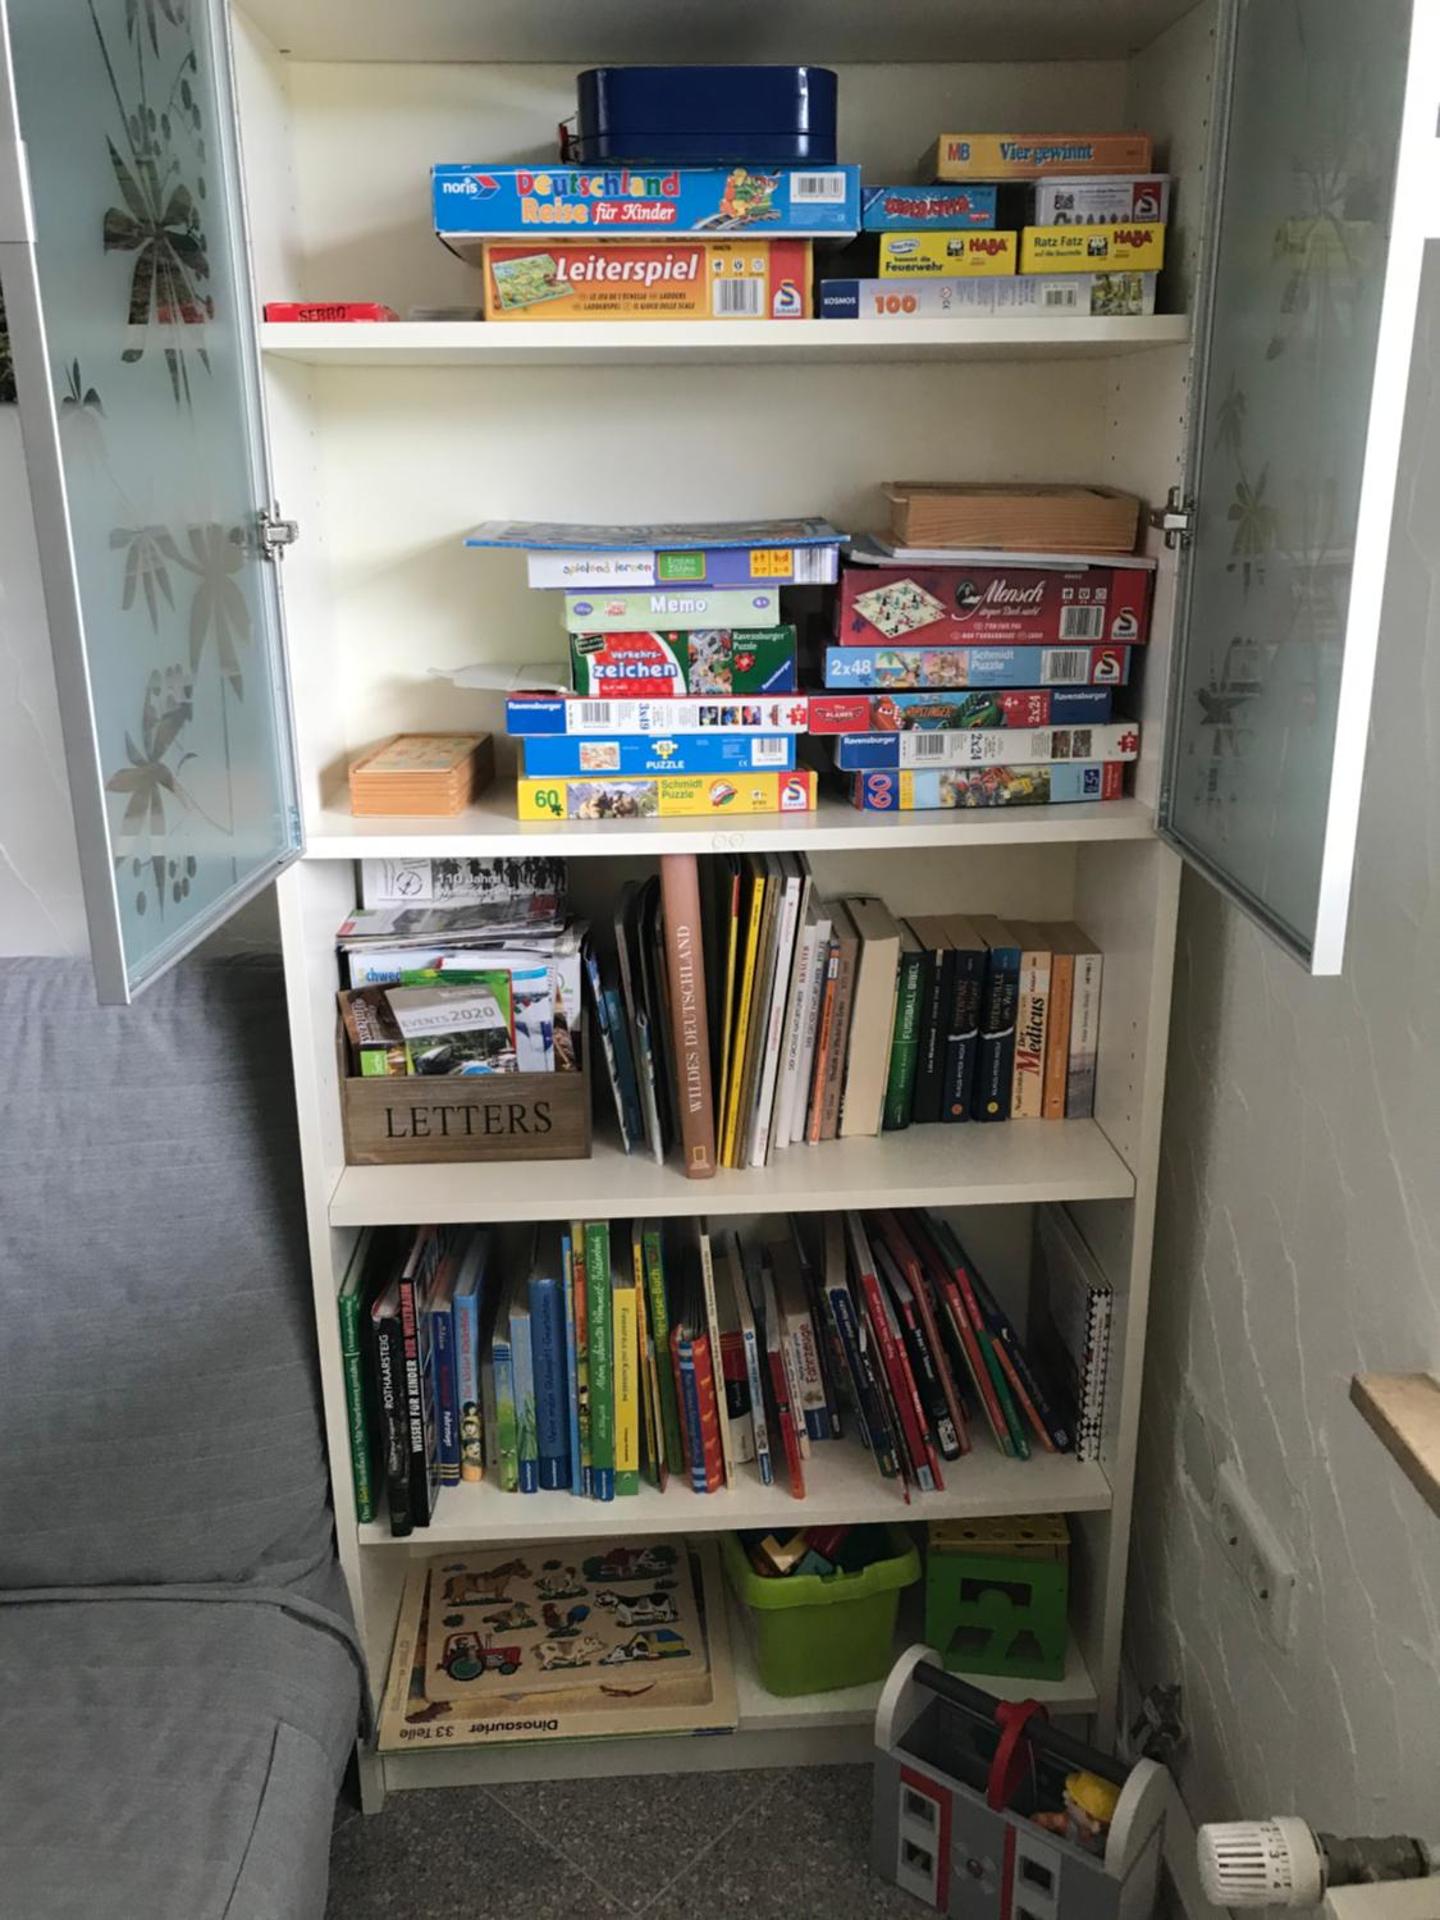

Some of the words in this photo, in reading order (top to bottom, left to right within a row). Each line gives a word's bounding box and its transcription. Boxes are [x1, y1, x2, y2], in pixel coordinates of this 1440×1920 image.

[948, 143, 970, 161] MB
[442, 177, 477, 194] noris
[515, 169, 681, 197] Deutschland
[521, 198, 589, 224] Reise
[593, 203, 618, 225] für
[620, 202, 676, 221] Kinder
[969, 238, 1008, 256] HABA
[1034, 237, 1057, 247] Ratz
[1060, 236, 1083, 246] Fatz
[1114, 230, 1153, 248] HABA
[556, 254, 698, 287] Leiterspiel
[885, 261, 943, 272] Feuerwehr
[823, 296, 856, 305] KOSMOS
[875, 294, 918, 314] 100
[650, 595, 707, 614] Memo
[971, 649, 1015, 662] Schmidt
[594, 661, 677, 678] zeichen
[971, 660, 1006, 671] Puzzle
[1053, 691, 1107, 701] Ravensburger
[507, 701, 562, 712] Ravensburger
[843, 736, 897, 746] Ravensburger
[645, 760, 686, 770] PUZZLE
[661, 779, 704, 790] Schmidt
[867, 773, 893, 809] 60
[534, 790, 559, 808] 60
[661, 789, 694, 800] Puzzle
[676, 925, 700, 1045] DEUTSCHLAND
[451, 1006, 496, 1022] 2020
[903, 991, 917, 1040] FUSSBALL
[1015, 996, 1045, 1076] Medicus
[686, 1055, 702, 1113] WILDES
[385, 1101, 553, 1138] LETTERS
[379, 1333, 394, 1409] ROTHAARSTEIG
[405, 1359, 420, 1396] KINDER
[409, 1418, 424, 1453] WISSEN
[399, 1725, 432, 1739] Teile
[432, 1724, 455, 1738] 33
[469, 1718, 560, 1734] Dinosaurier
[1269, 1850, 1280, 1859] 3
